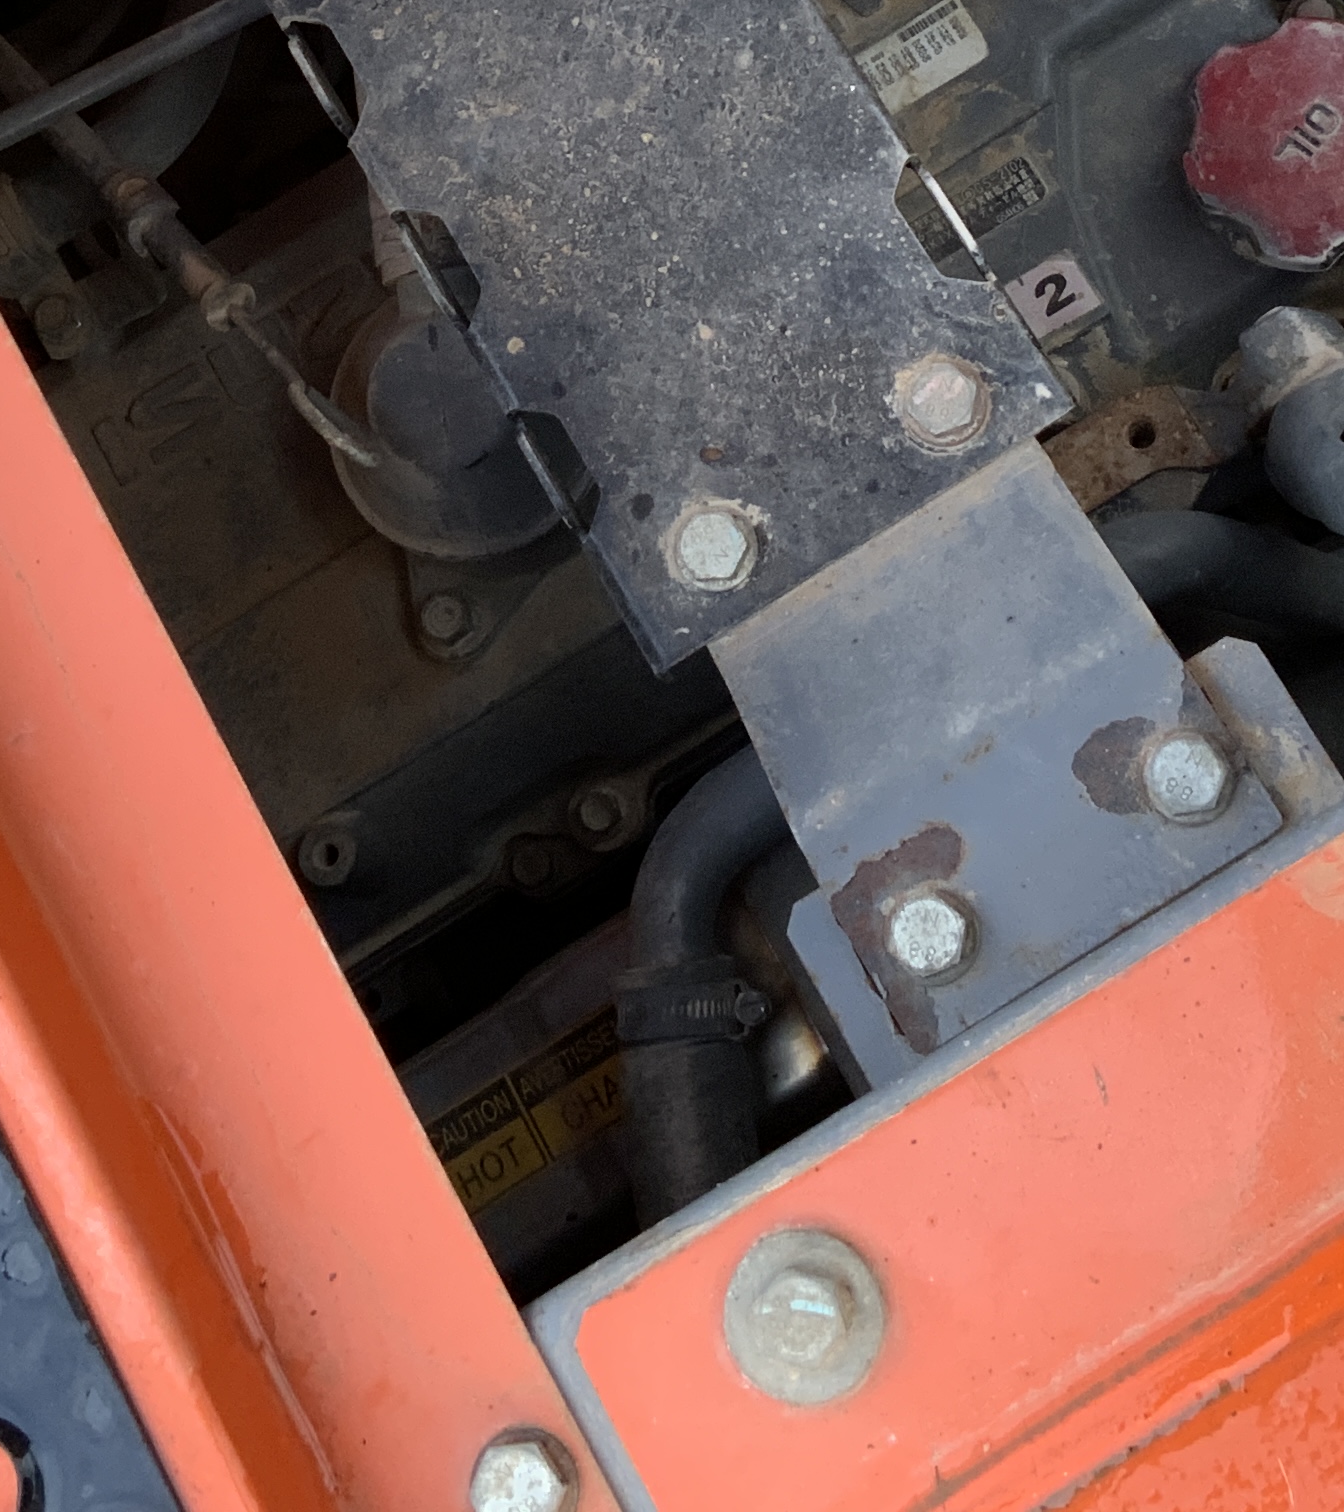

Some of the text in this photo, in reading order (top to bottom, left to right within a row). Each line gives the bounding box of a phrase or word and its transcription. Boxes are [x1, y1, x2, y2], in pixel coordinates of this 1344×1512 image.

[1274, 102, 1340, 159] OIL
[1034, 271, 1077, 318] 2
[561, 1075, 619, 1130] CHA
[457, 1136, 520, 1199] HOT
